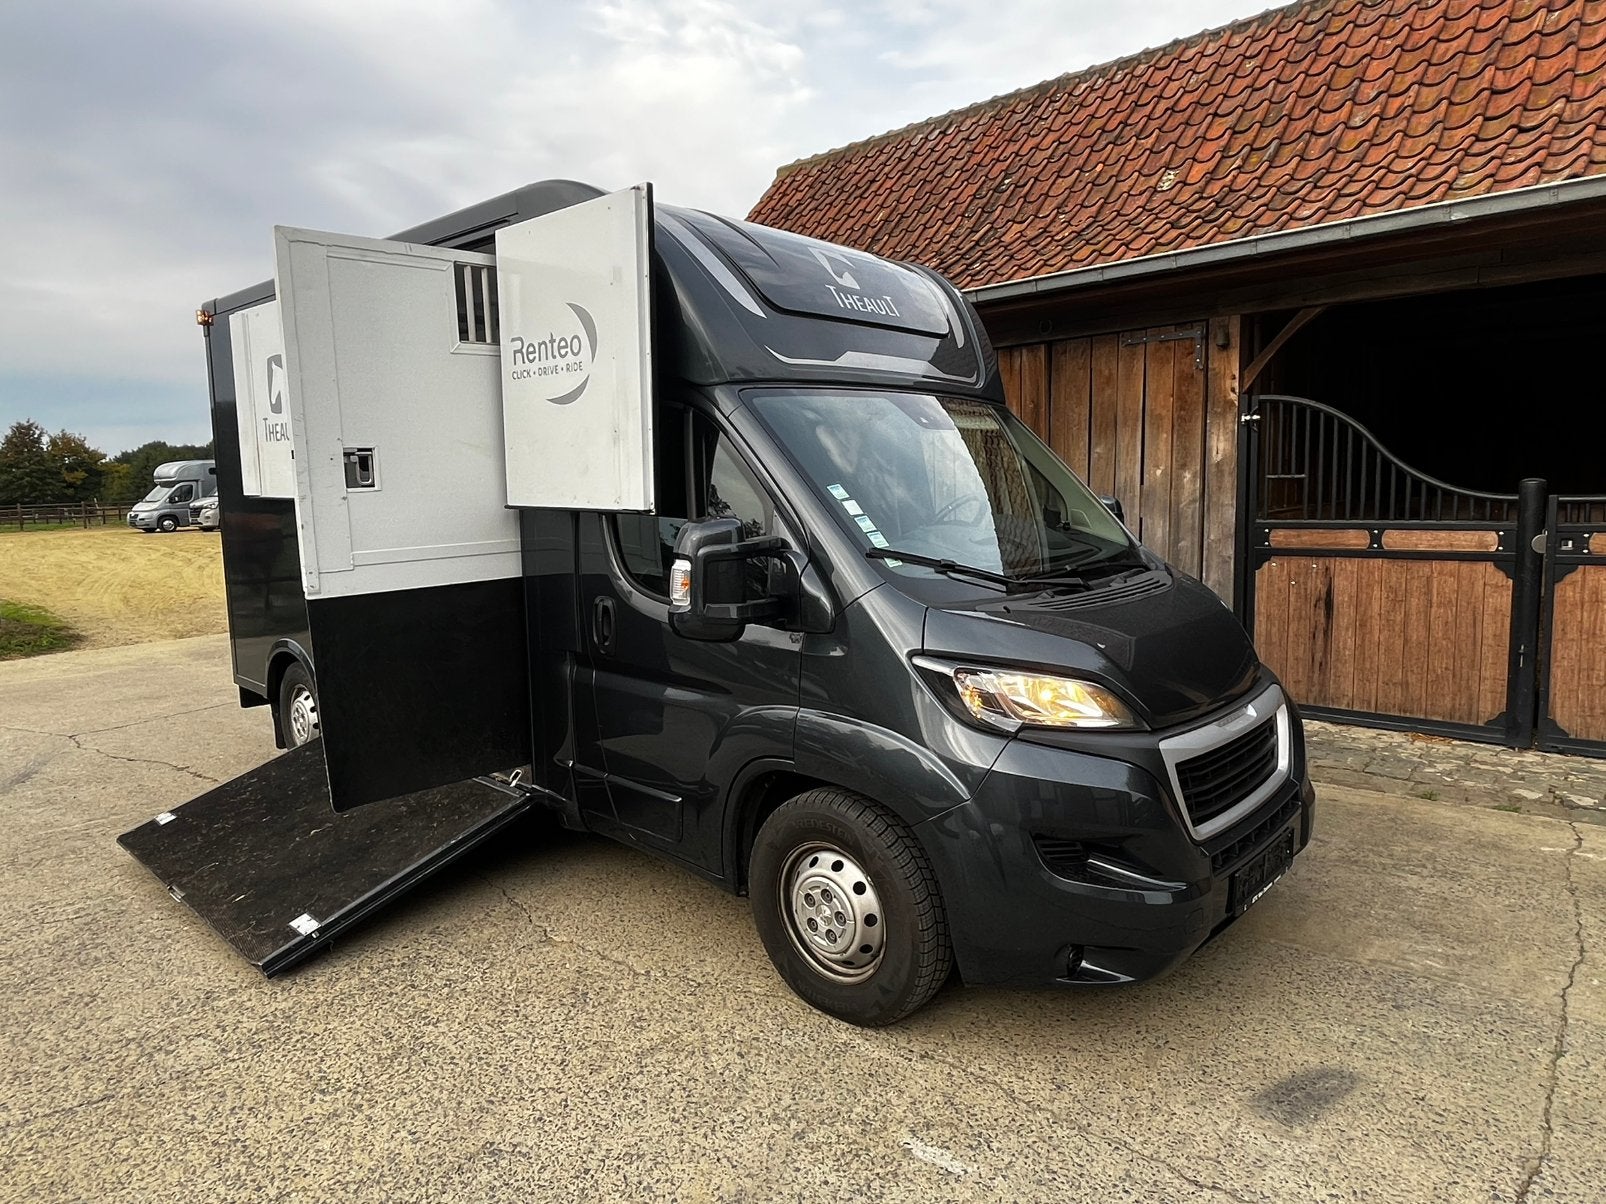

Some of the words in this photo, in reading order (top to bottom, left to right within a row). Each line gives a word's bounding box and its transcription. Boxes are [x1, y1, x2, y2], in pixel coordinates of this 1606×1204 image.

[824, 284, 900, 317] THEAULT
[510, 332, 582, 366] Renteo
[511, 369, 532, 380] CLICK
[537, 364, 559, 377] DRIVE
[565, 361, 583, 373] RIDE
